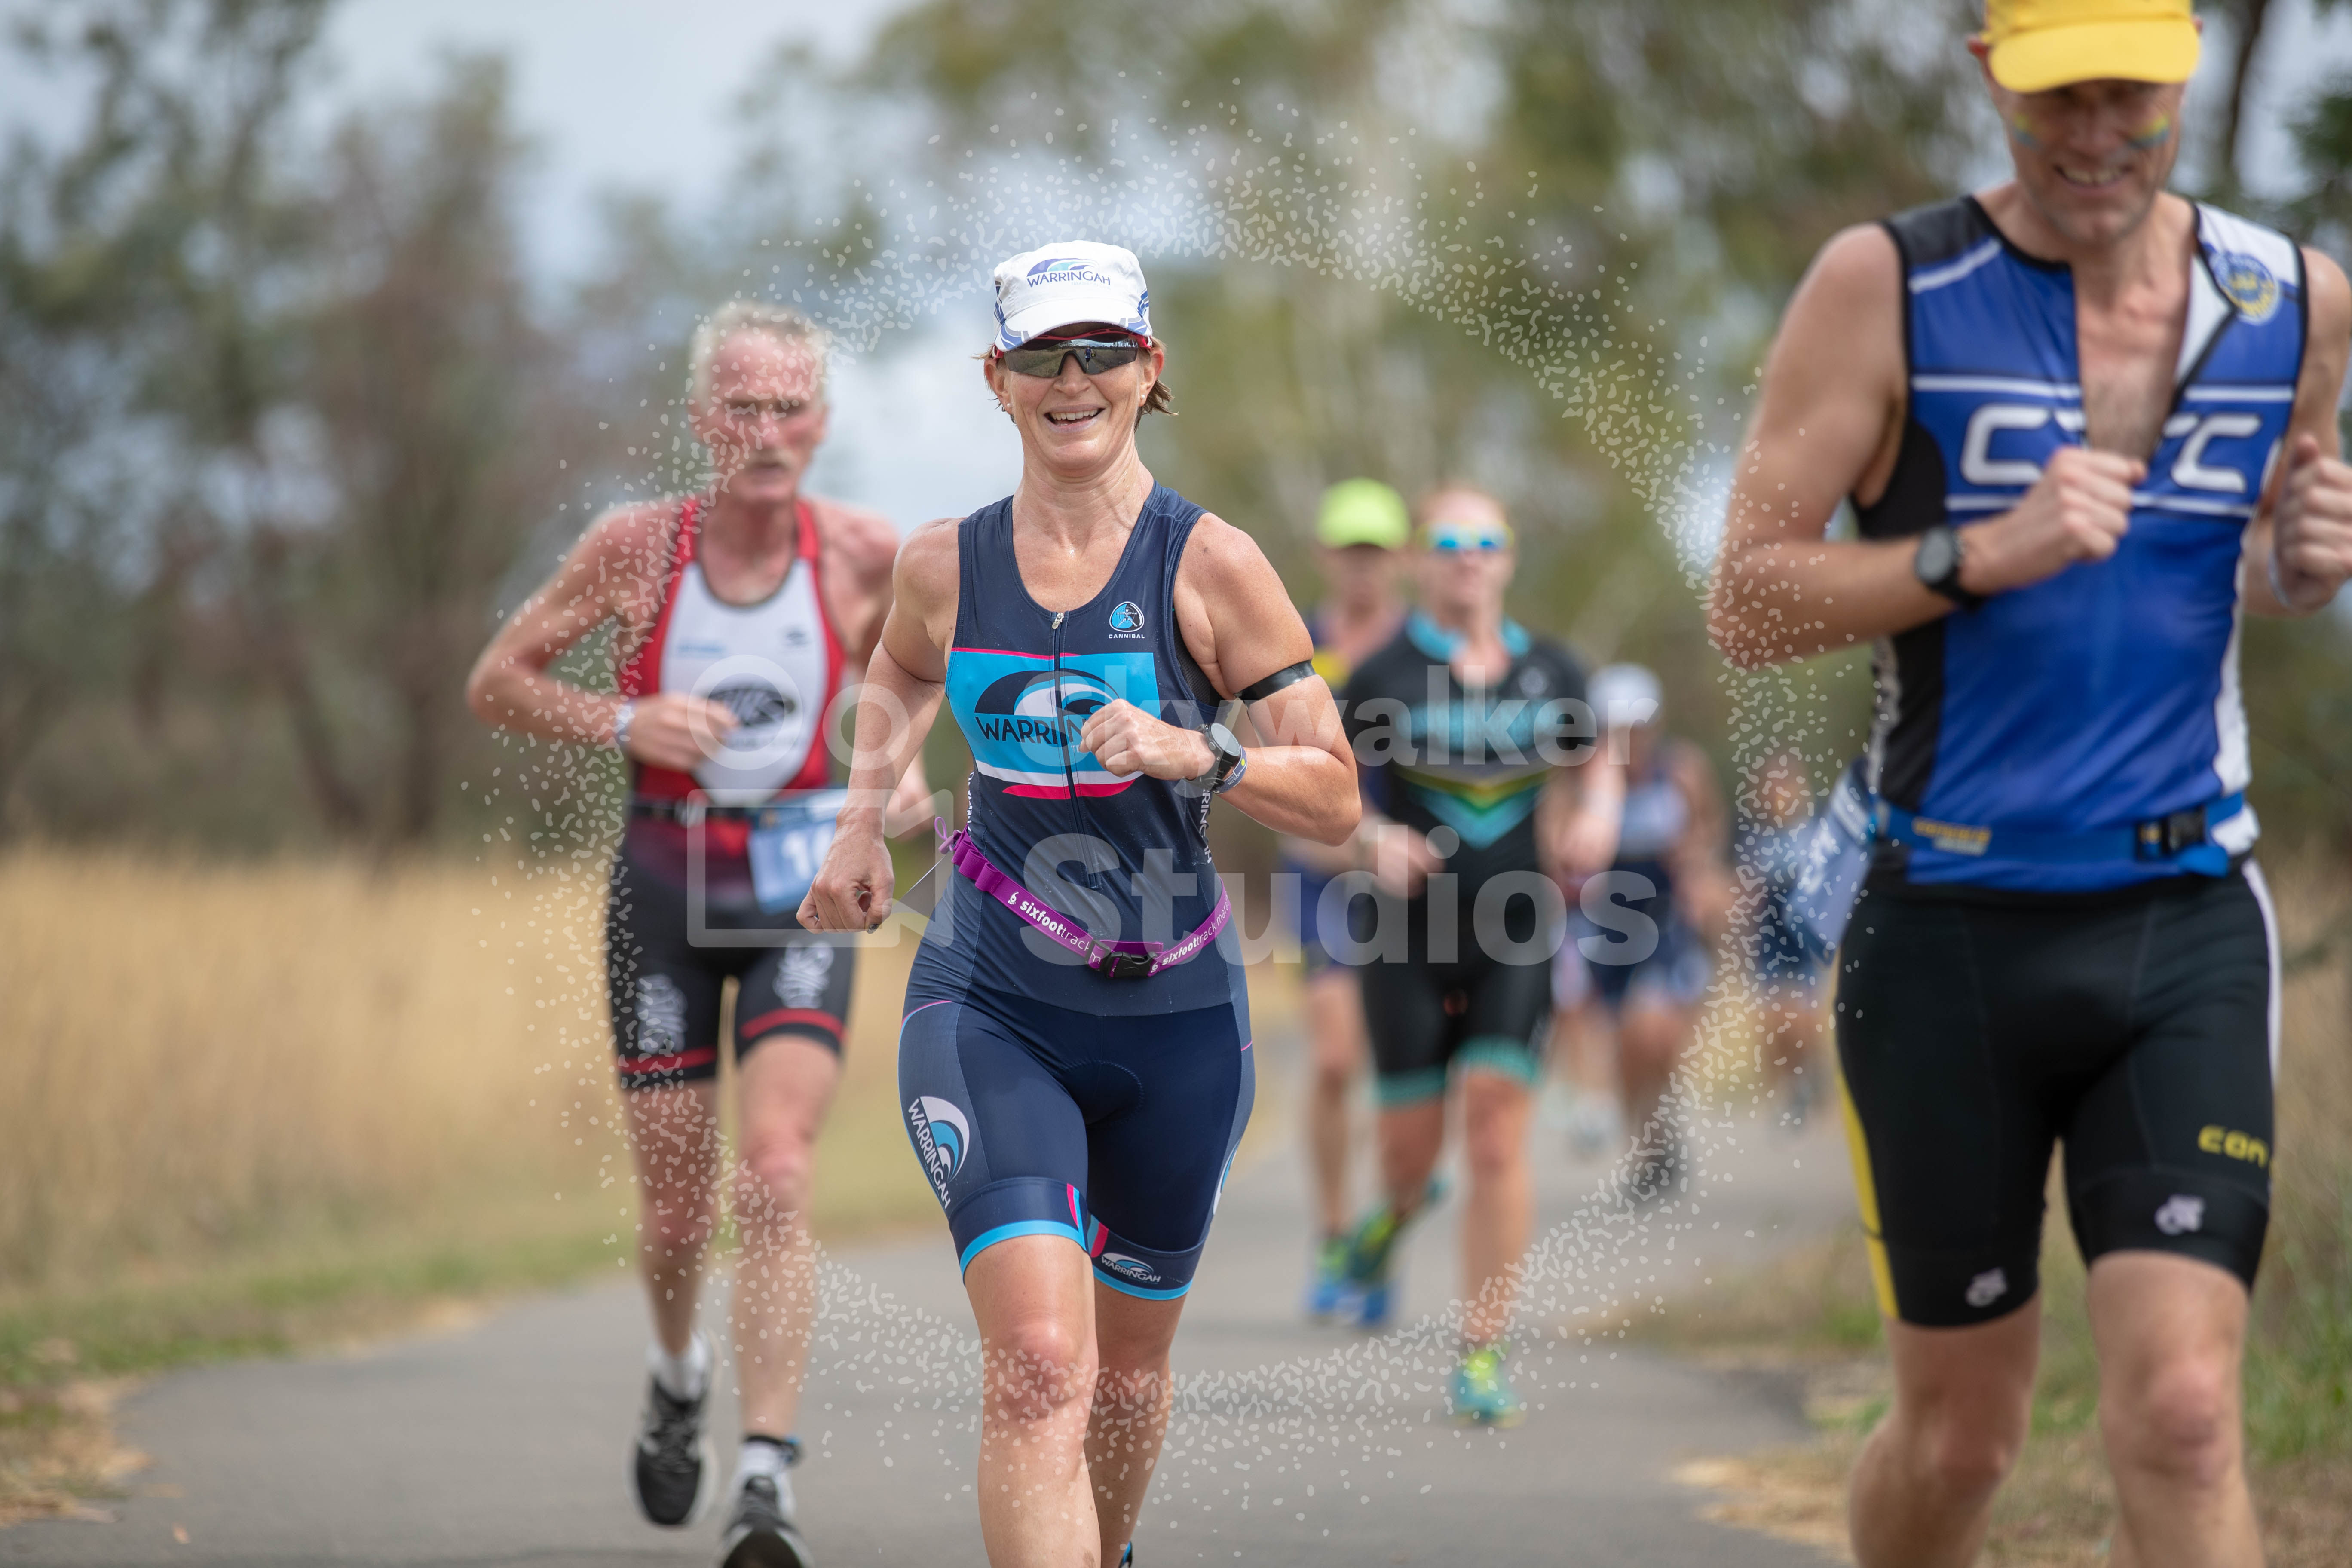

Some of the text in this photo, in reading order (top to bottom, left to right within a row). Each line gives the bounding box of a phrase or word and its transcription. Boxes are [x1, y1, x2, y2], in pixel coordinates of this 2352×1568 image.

[1026, 271, 1110, 288] WARRINGAH
[974, 716, 1088, 744] WARRIN
[1162, 922, 1217, 966] sixfoottrack
[908, 1098, 951, 1209] WARRINGAH
[1102, 1256, 1161, 1283] WARRINGAH
